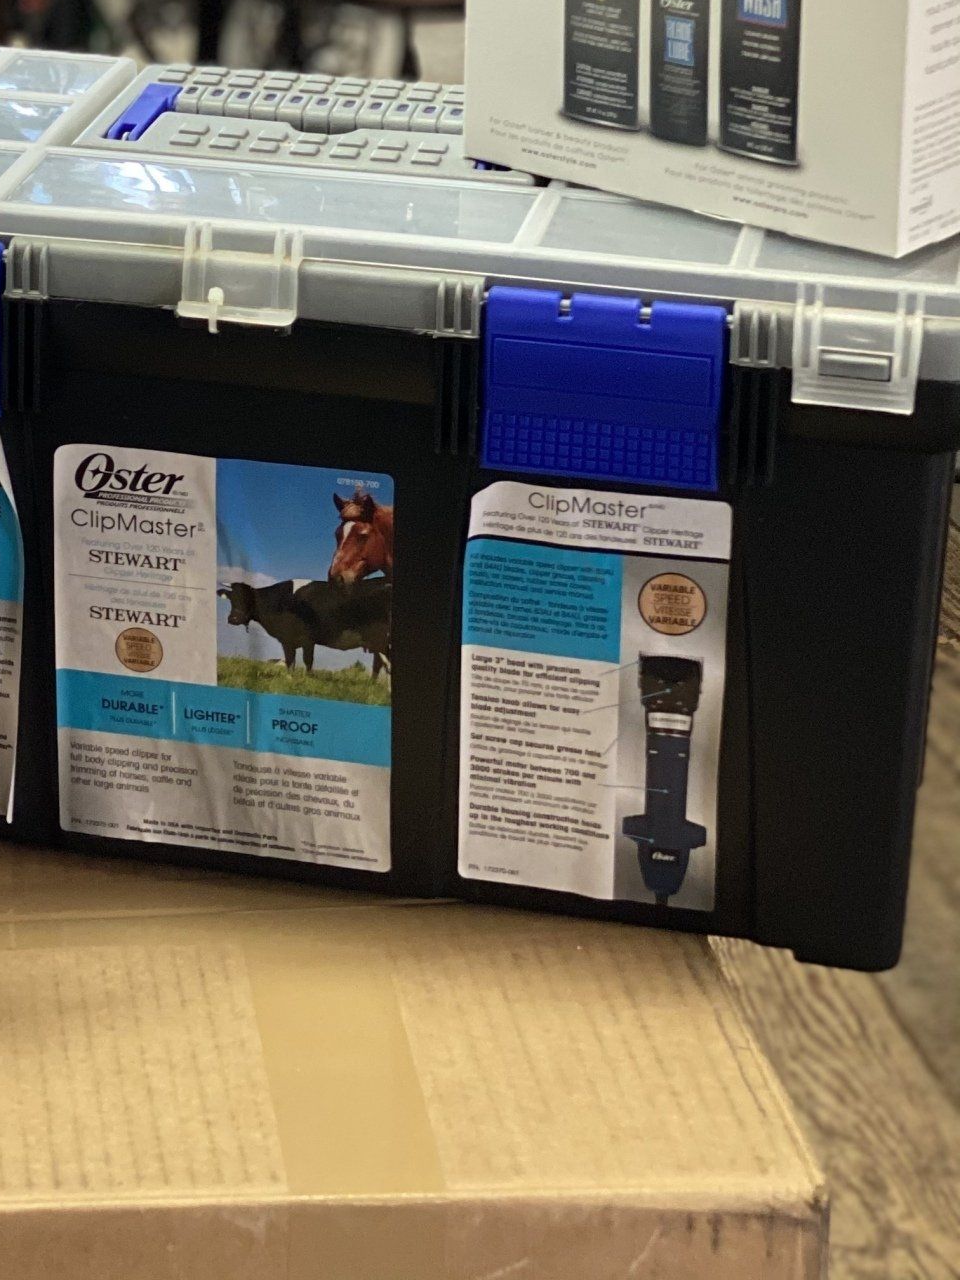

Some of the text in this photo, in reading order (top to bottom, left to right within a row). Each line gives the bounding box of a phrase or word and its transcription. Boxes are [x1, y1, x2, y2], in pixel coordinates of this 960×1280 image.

[74, 452, 185, 496] Oster
[527, 491, 645, 520] ClipMaster
[70, 508, 198, 539] ClipMaster
[582, 519, 639, 532] STEWART
[642, 537, 701, 550] STEWART
[88, 548, 184, 572] STEWART
[650, 584, 695, 593] VARIABLE
[653, 593, 689, 604] SPEED
[88, 605, 184, 628] STEWART
[648, 615, 695, 626] VARIABLE
[271, 718, 319, 736] PROOF
[70, 741, 171, 761] Variable speed clipper for
[84, 755, 105, 766] body
[107, 758, 139, 771] clipping
[142, 761, 158, 771] and
[160, 764, 198, 776] precision
[93, 779, 114, 789] large
[115, 782, 149, 792] animals
[175, 778, 191, 787] and
